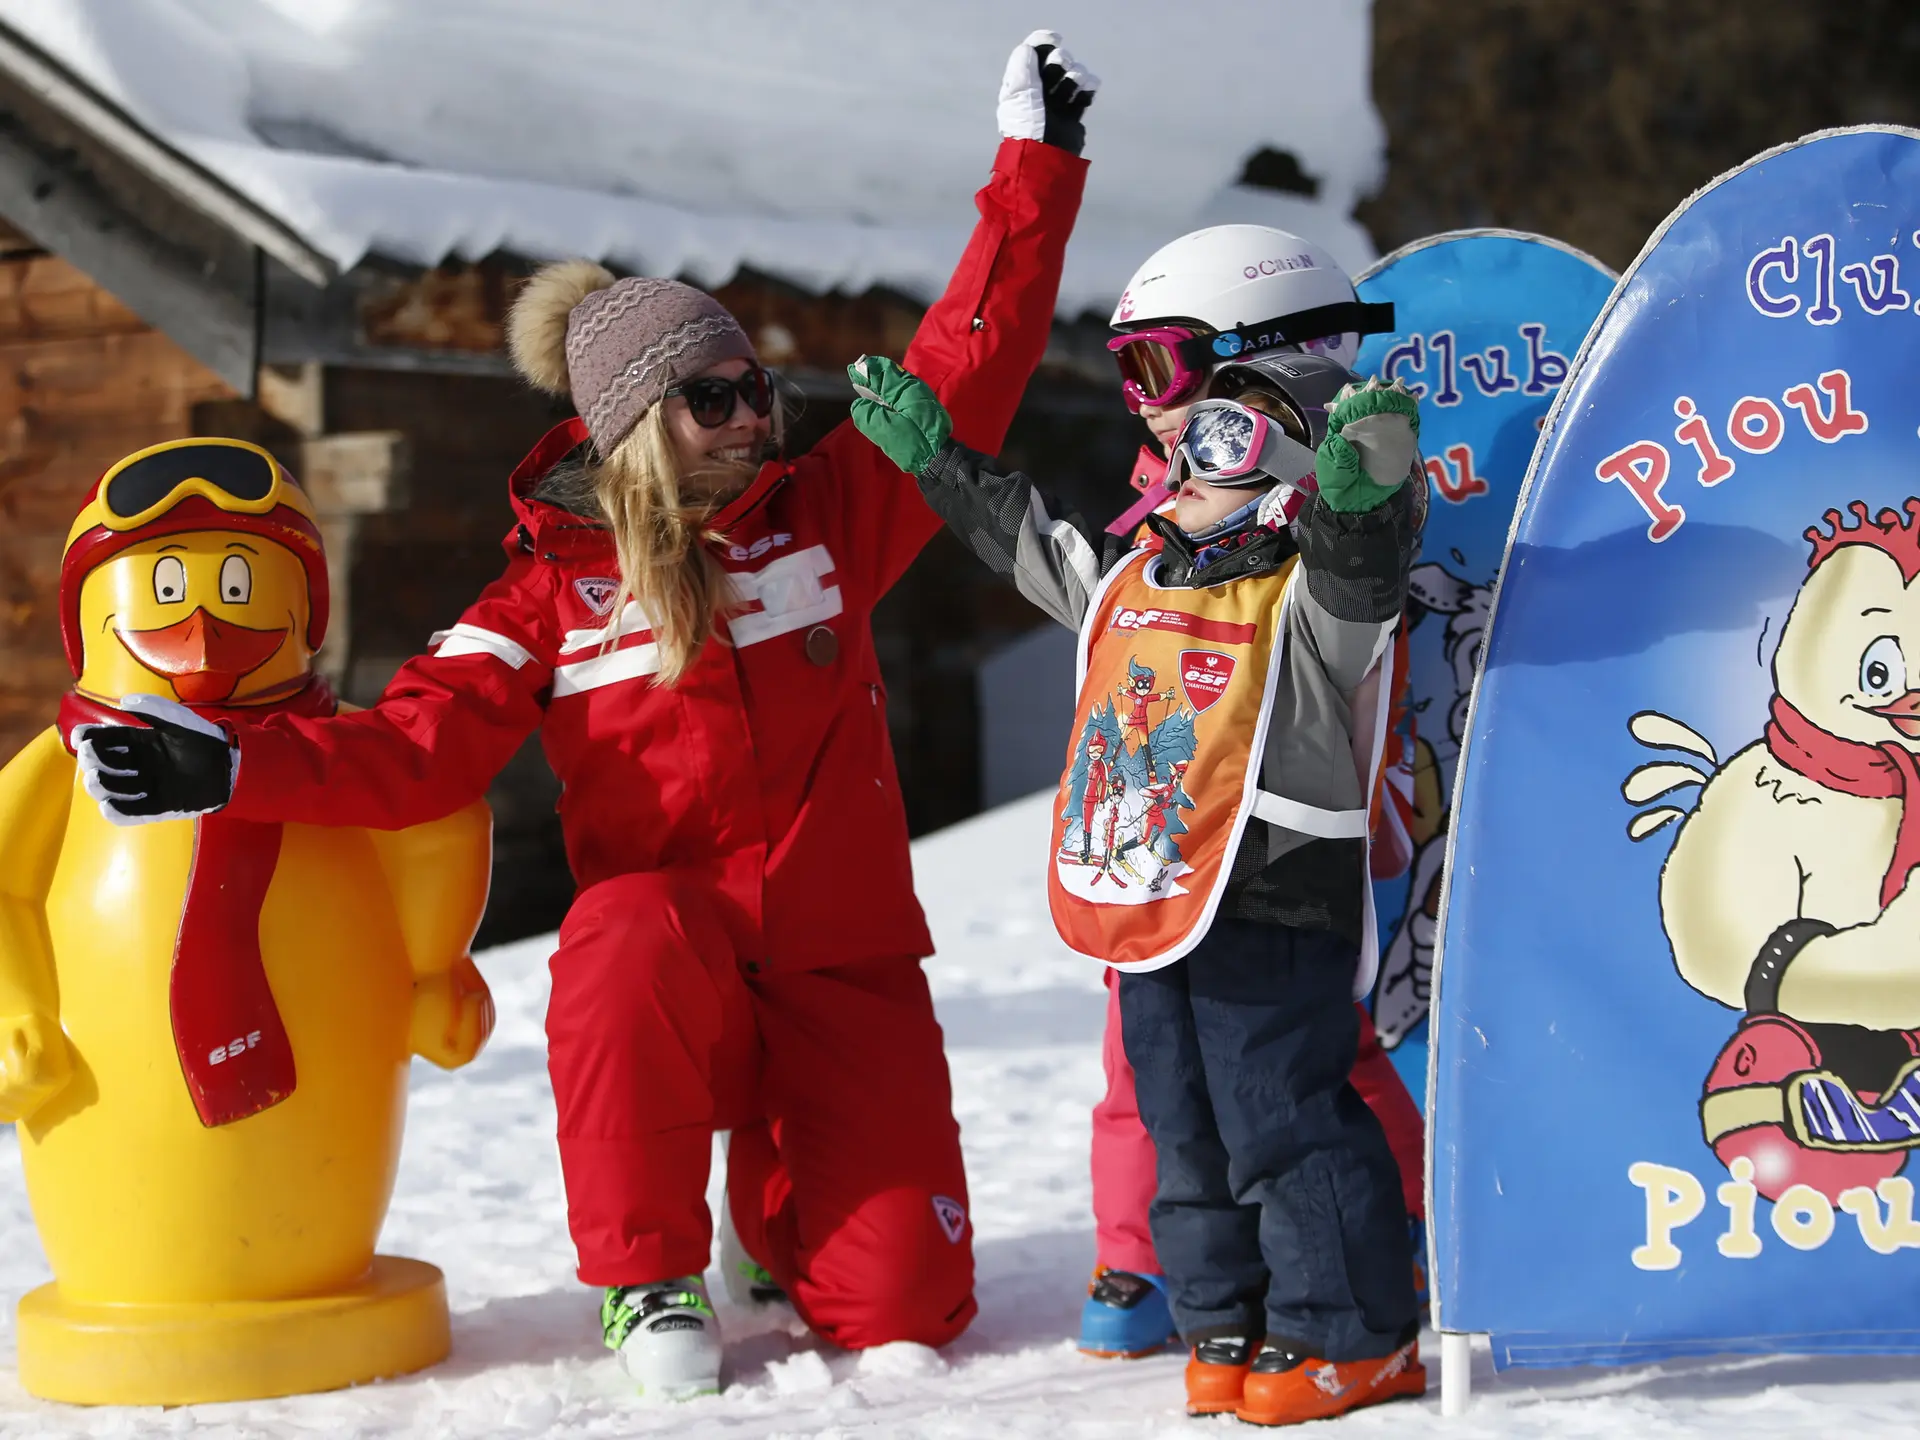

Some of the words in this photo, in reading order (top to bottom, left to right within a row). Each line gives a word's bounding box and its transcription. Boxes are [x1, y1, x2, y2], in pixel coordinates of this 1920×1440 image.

[1746, 234, 1920, 325] Clu
[1382, 323, 1570, 407] Club
[1595, 369, 1868, 543] Piou
[1185, 681, 1224, 694] CHANTEMERLE
[1628, 1156, 1920, 1271] Piou
